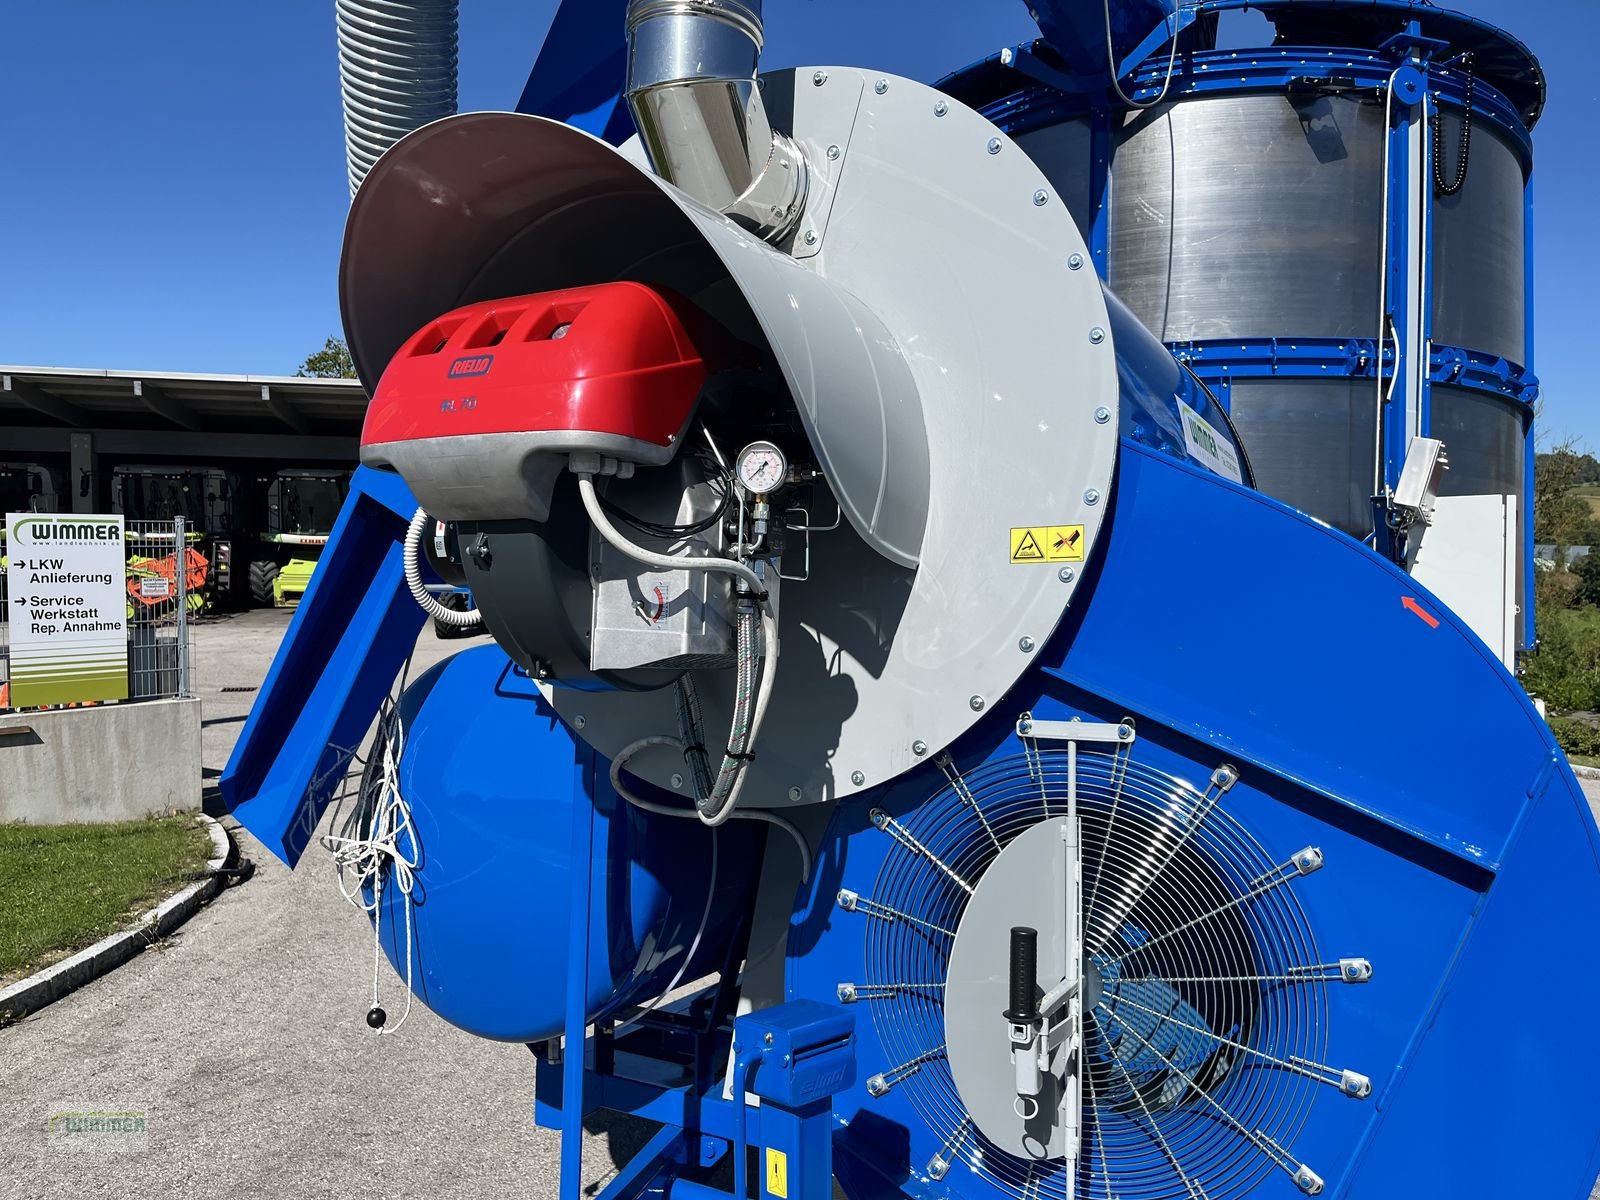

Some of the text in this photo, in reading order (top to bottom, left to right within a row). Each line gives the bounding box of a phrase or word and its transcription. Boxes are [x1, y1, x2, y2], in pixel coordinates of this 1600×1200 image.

[450, 358, 490, 375] RIELLO
[441, 397, 478, 412] RL 70
[31, 524, 120, 540] WIMMER
[29, 559, 64, 570] LKW
[30, 573, 112, 585] Anlieferung
[30, 595, 84, 607] Service
[30, 608, 99, 620] Werkstatt
[31, 621, 121, 635] Rep. Annahme
